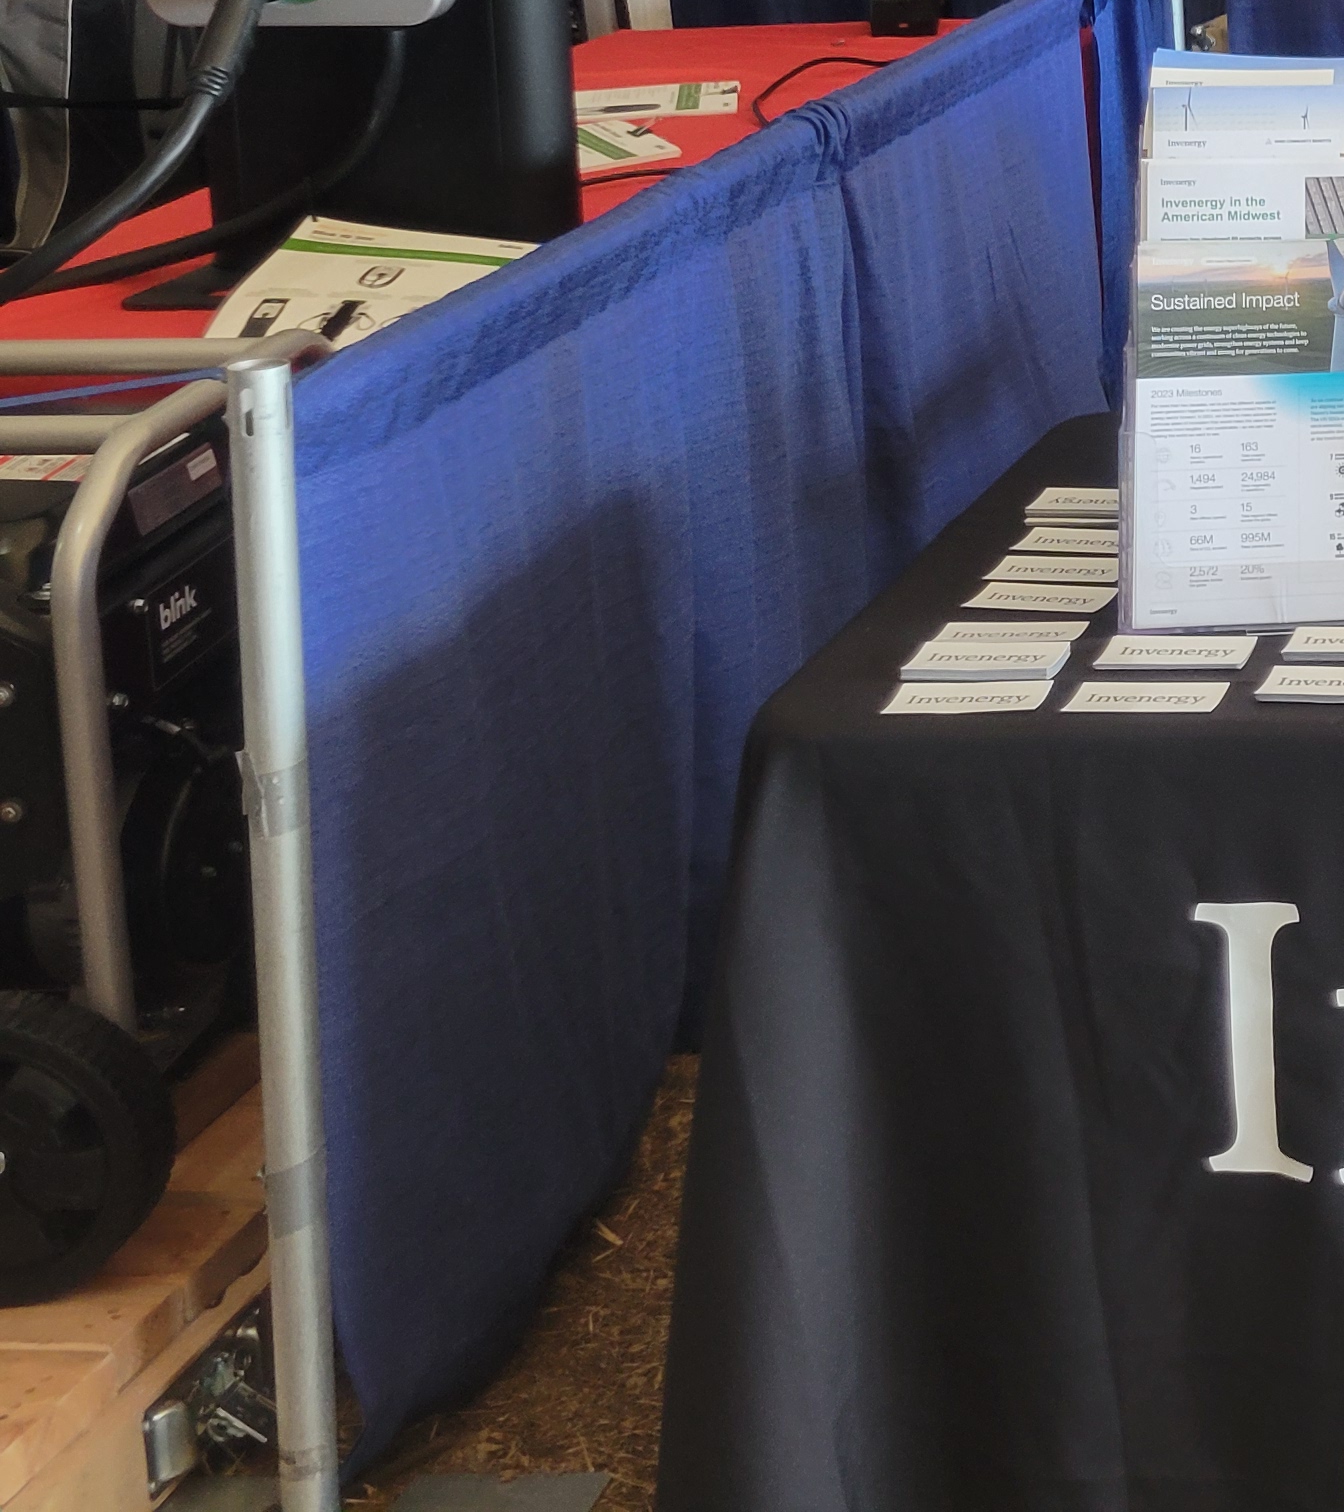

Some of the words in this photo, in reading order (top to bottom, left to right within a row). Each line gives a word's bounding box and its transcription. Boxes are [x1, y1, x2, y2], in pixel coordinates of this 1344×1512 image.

[1167, 138, 1208, 149] Invenergy
[1161, 197, 1226, 210] Invenergy
[1229, 196, 1242, 207] in
[1245, 196, 1266, 207] the
[1161, 211, 1224, 223] American
[1227, 210, 1281, 221] Midwest
[1150, 292, 1237, 311] Sustained
[1242, 291, 1301, 311] Impact
[1150, 389, 1174, 399] 2023
[1176, 388, 1223, 398] Milestones
[1190, 444, 1202, 454] 16
[1241, 441, 1259, 452] 163
[1240, 471, 1276, 482] 24,984
[1190, 504, 1198, 515] 3
[1240, 502, 1253, 512] 15
[1189, 534, 1214, 546] 66M
[1240, 532, 1271, 543] 995M
[1006, 565, 1114, 577] Invenergy
[986, 592, 1095, 605] Invenergy
[159, 584, 198, 630] blink
[951, 629, 1068, 640] Invenergy
[1118, 645, 1236, 658] Invenergy
[926, 652, 1047, 664] Invenergy
[905, 693, 1031, 705] Invenergy
[1085, 692, 1207, 705] Invenergy
